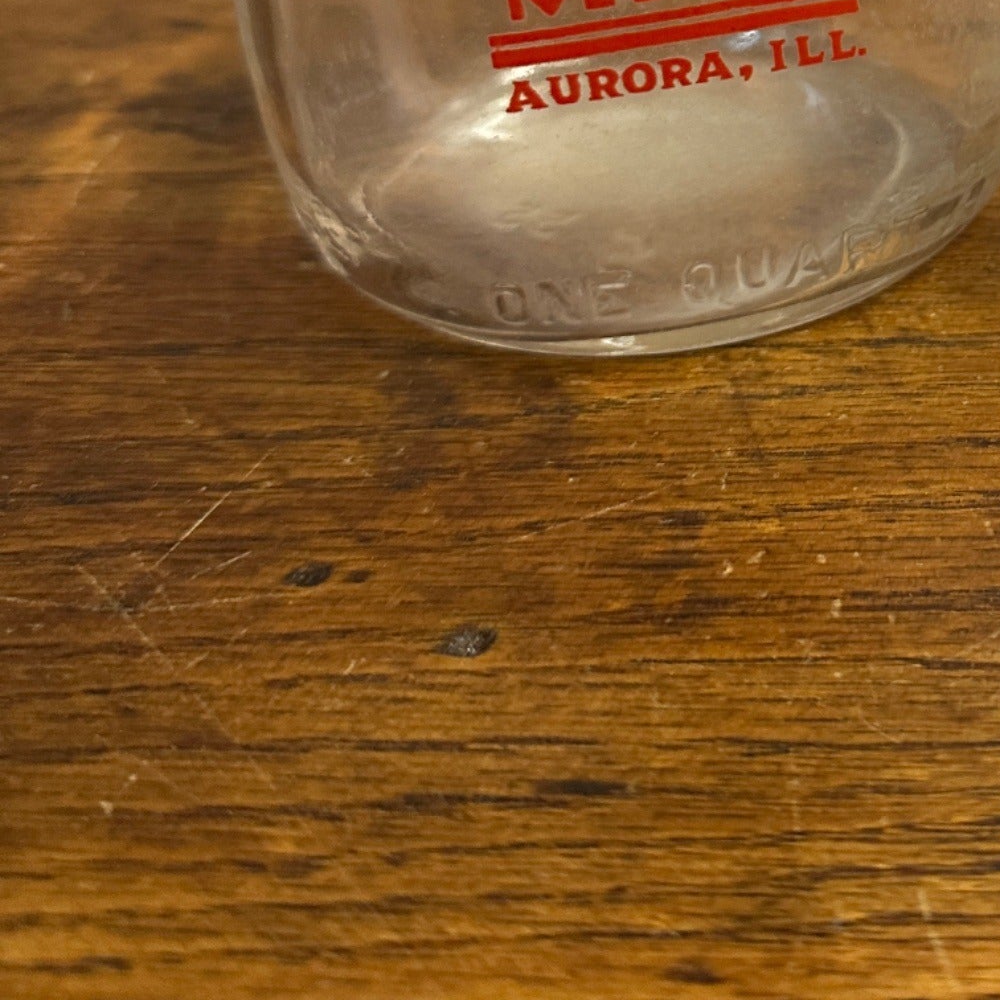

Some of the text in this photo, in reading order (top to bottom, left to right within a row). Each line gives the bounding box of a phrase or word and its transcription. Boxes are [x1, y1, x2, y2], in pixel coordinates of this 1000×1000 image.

[506, 29, 868, 113] AURORA, ILL.
[493, 265, 633, 327] ONE
